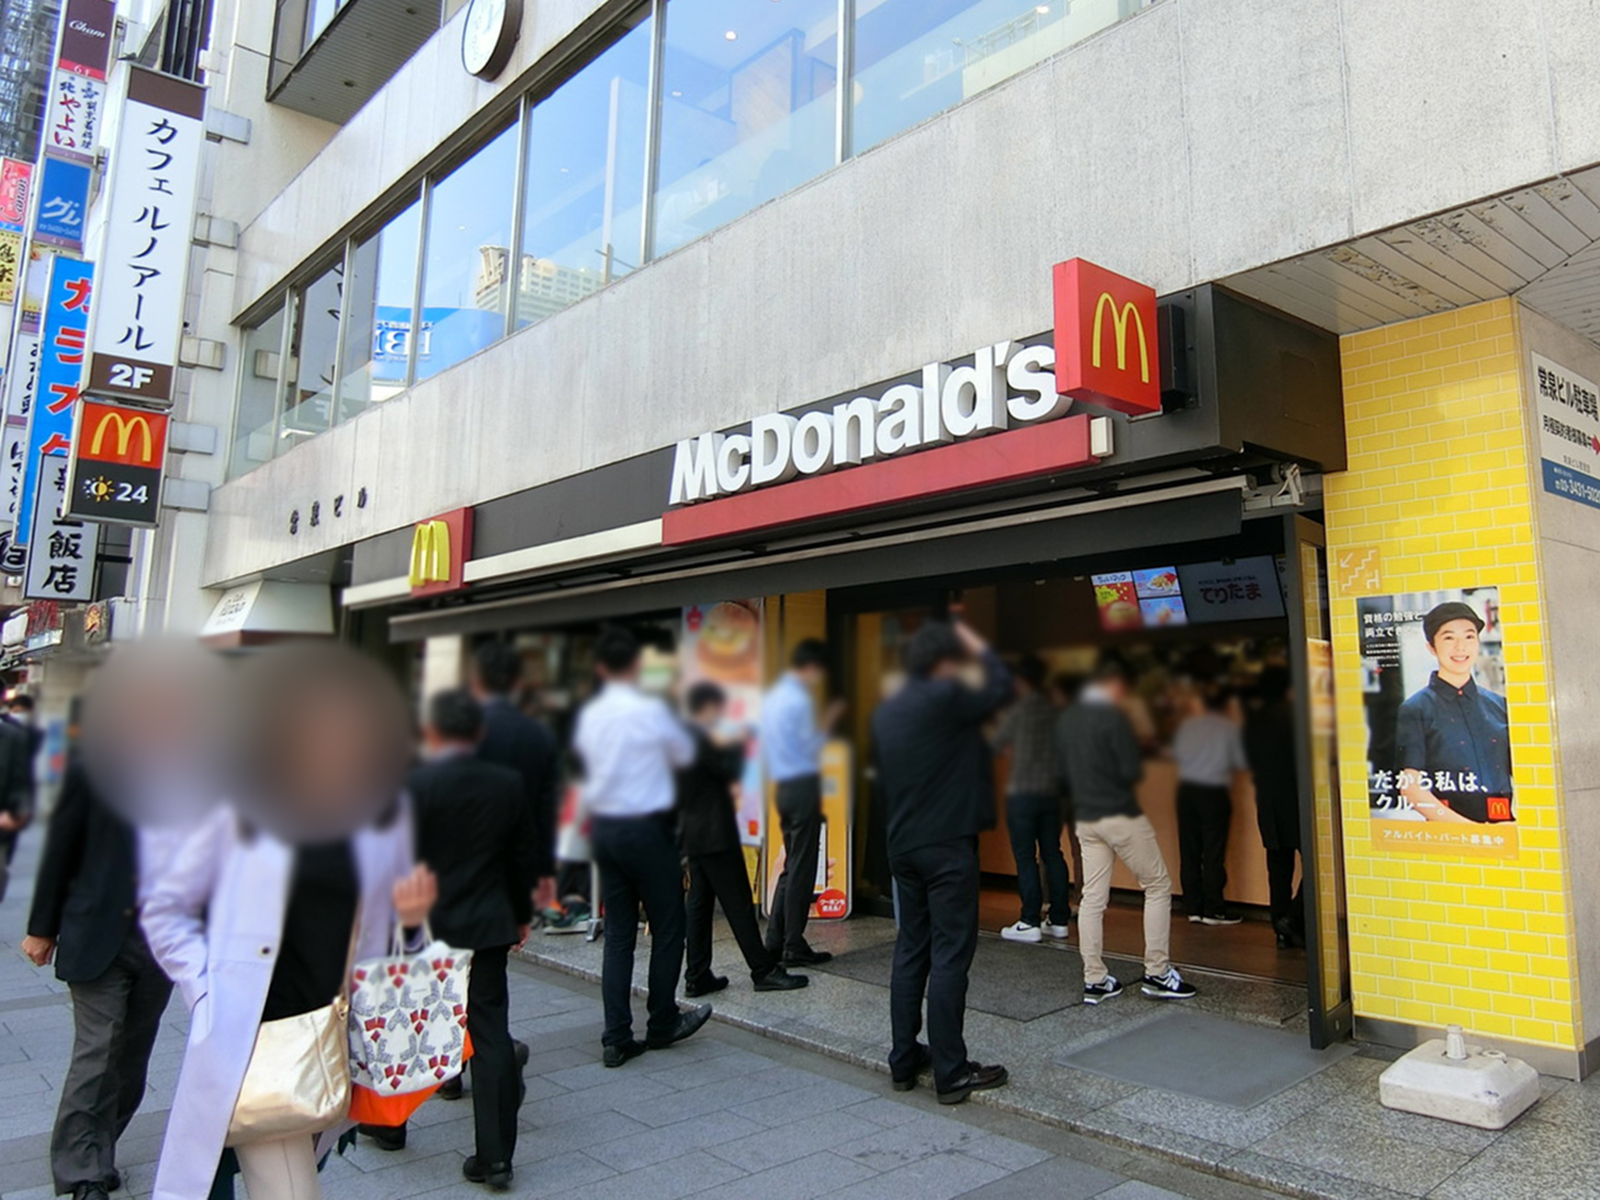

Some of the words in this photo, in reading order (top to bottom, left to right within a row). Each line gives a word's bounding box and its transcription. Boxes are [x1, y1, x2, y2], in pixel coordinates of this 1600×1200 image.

[116, 117, 178, 351] カフェルノアール
[109, 363, 154, 389] 2F
[669, 340, 1060, 505] McDonald's
[116, 482, 149, 504] 24
[1199, 583, 1262, 604] てりたま
[1374, 770, 1489, 793] だから私は、
[1376, 794, 1445, 816] クルー。
